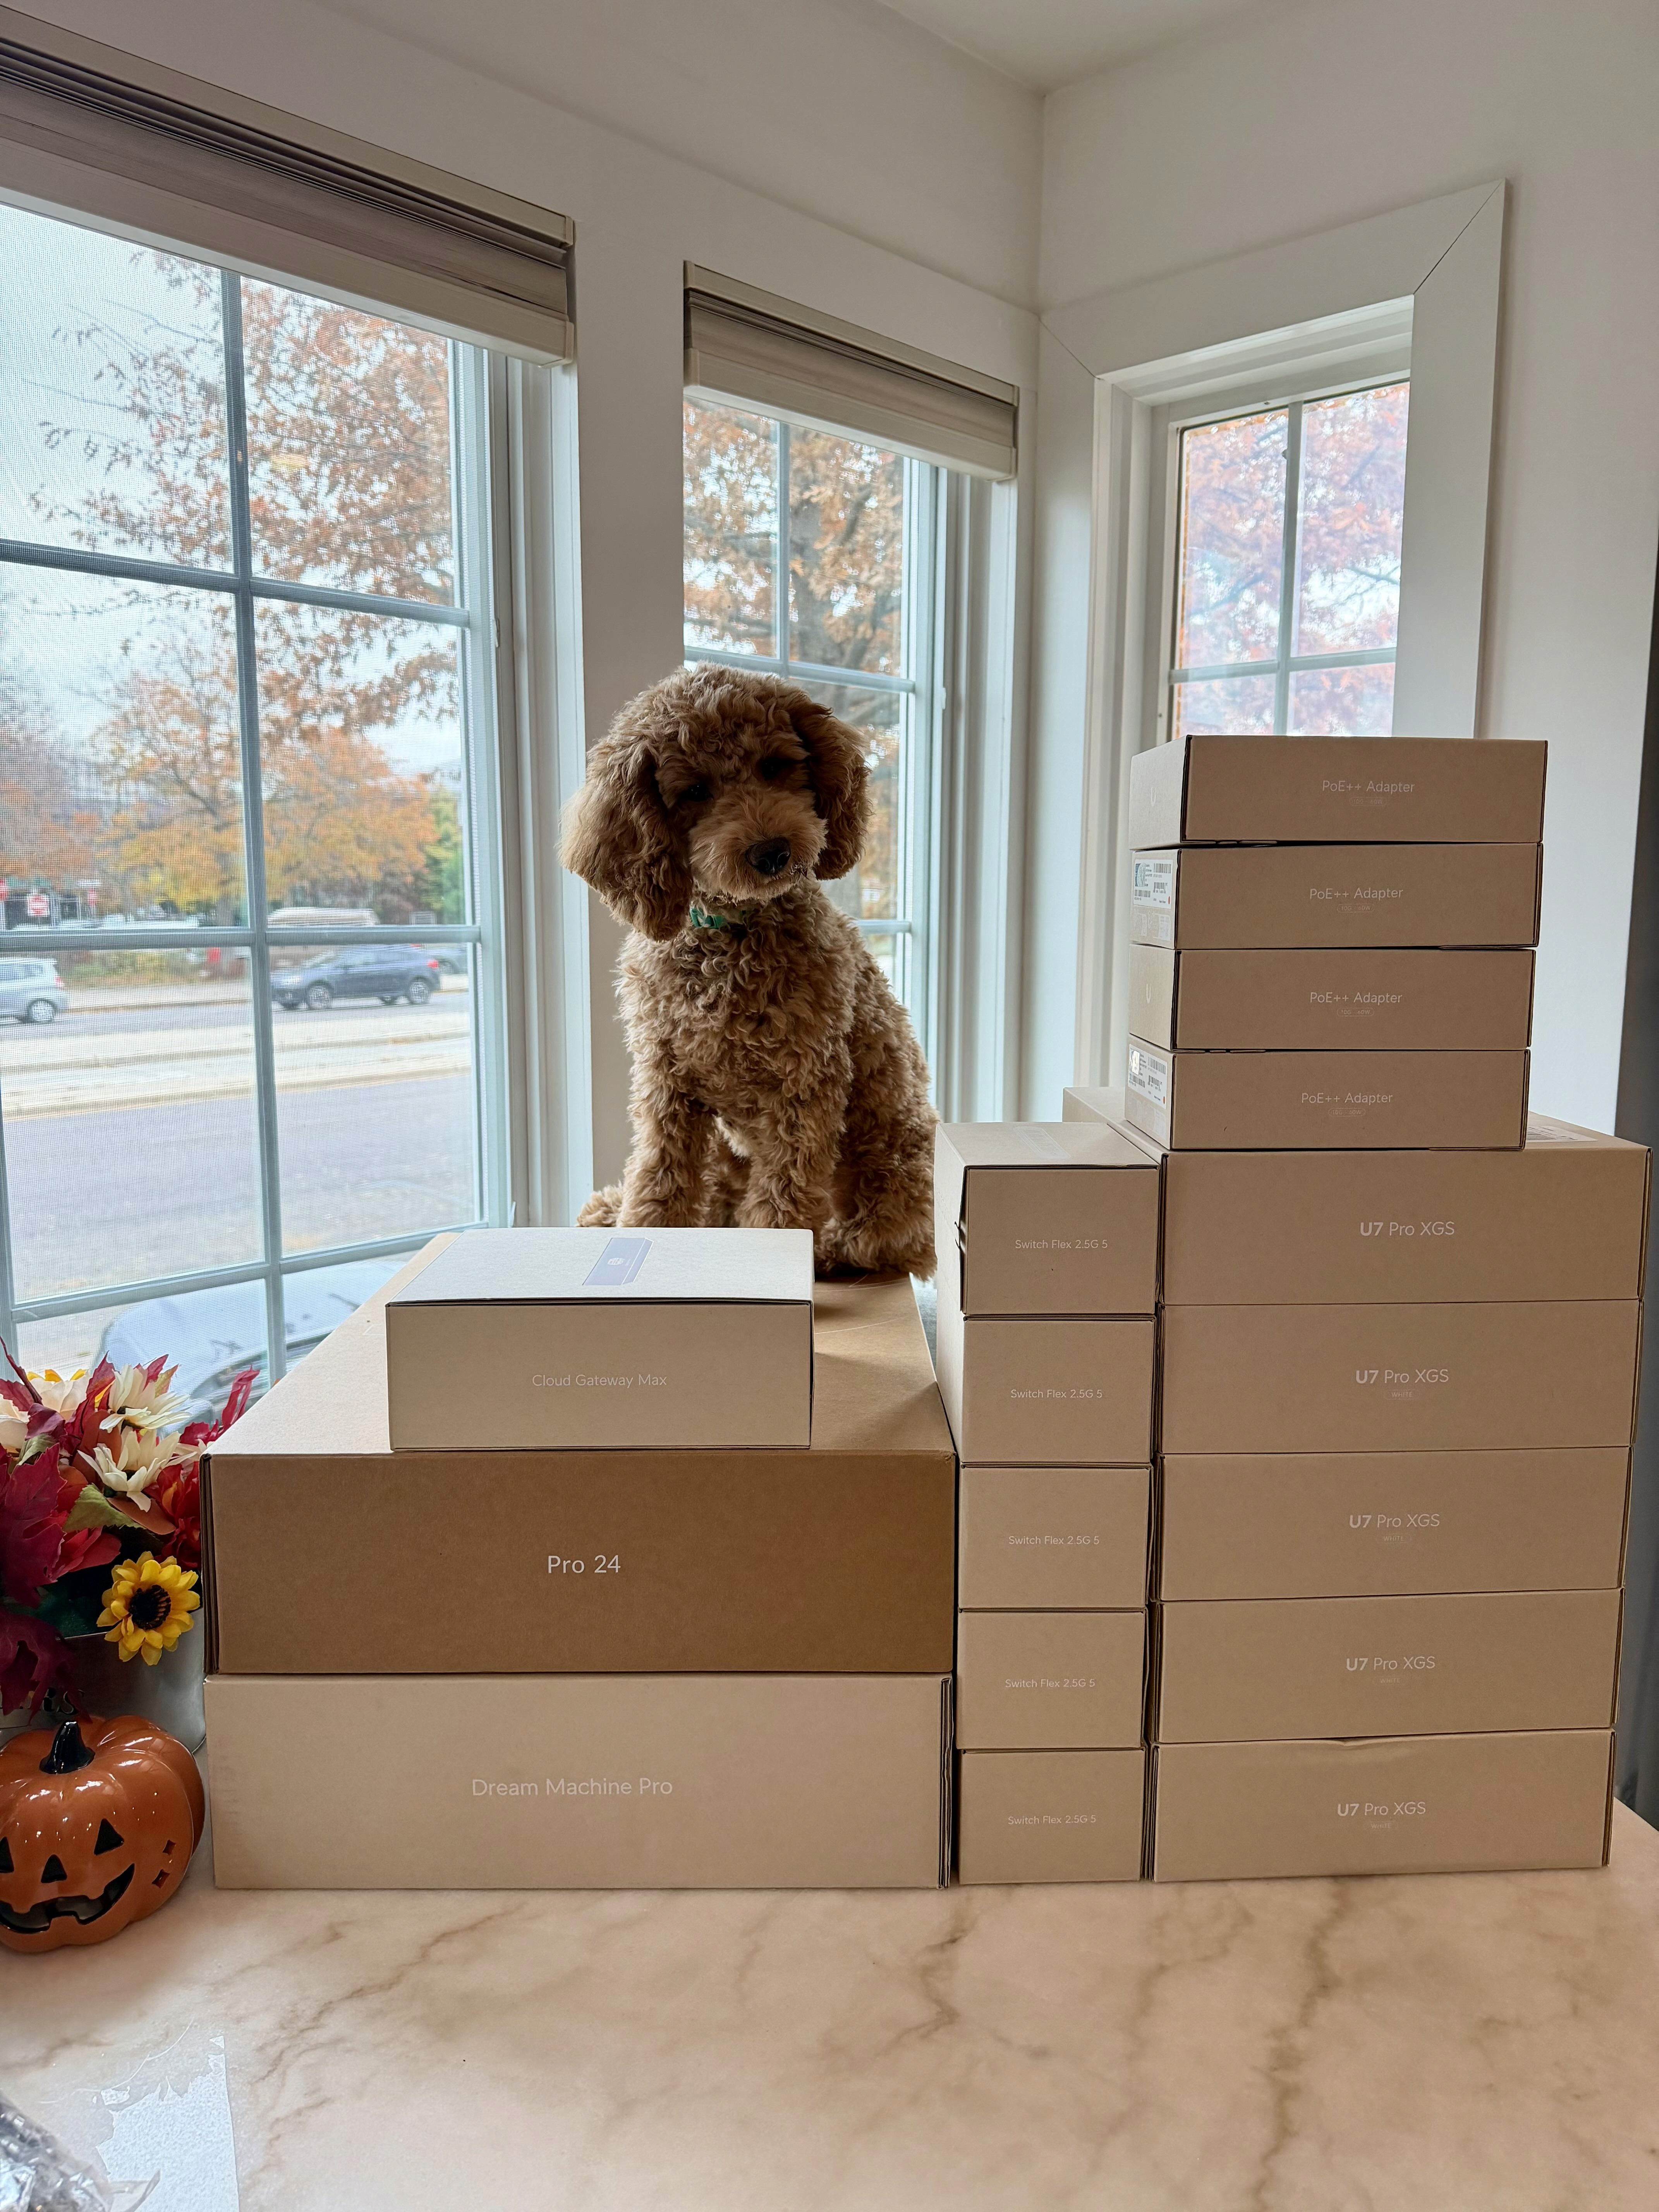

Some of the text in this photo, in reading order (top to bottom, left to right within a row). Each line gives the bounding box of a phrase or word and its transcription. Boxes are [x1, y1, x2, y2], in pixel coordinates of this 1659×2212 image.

[1322, 780, 1415, 795] PoE++ Adapter
[1309, 887, 1403, 901] PoE++ Adapter
[1310, 992, 1403, 1006] PoE++ Adapter
[1301, 1092, 1393, 1106] PoE++ Adapter
[1360, 1221, 1455, 1237] U7 Pro XGS
[1015, 1239, 1108, 1249] Switch Flex 2.5G 5
[532, 1374, 667, 1389] Cloud Gateway Max
[1356, 1369, 1449, 1384] U7 Pro XGS
[1010, 1389, 1103, 1398] Switch Flex 2.5G 5
[1349, 1513, 1440, 1528] U7 Pro XGS
[1008, 1535, 1100, 1545] Switch Flex 2.5G 5
[548, 1554, 621, 1574] Pro 24
[1346, 1656, 1436, 1671] U7 Pro XGS
[1005, 1678, 1095, 1688] Switch Flex 2.5G 5
[472, 1778, 673, 1796] Dream Machine Pro
[1337, 1801, 1426, 1817] U7 Pro XGS
[1008, 1815, 1096, 1825] Switch Flex 2.5G 5
